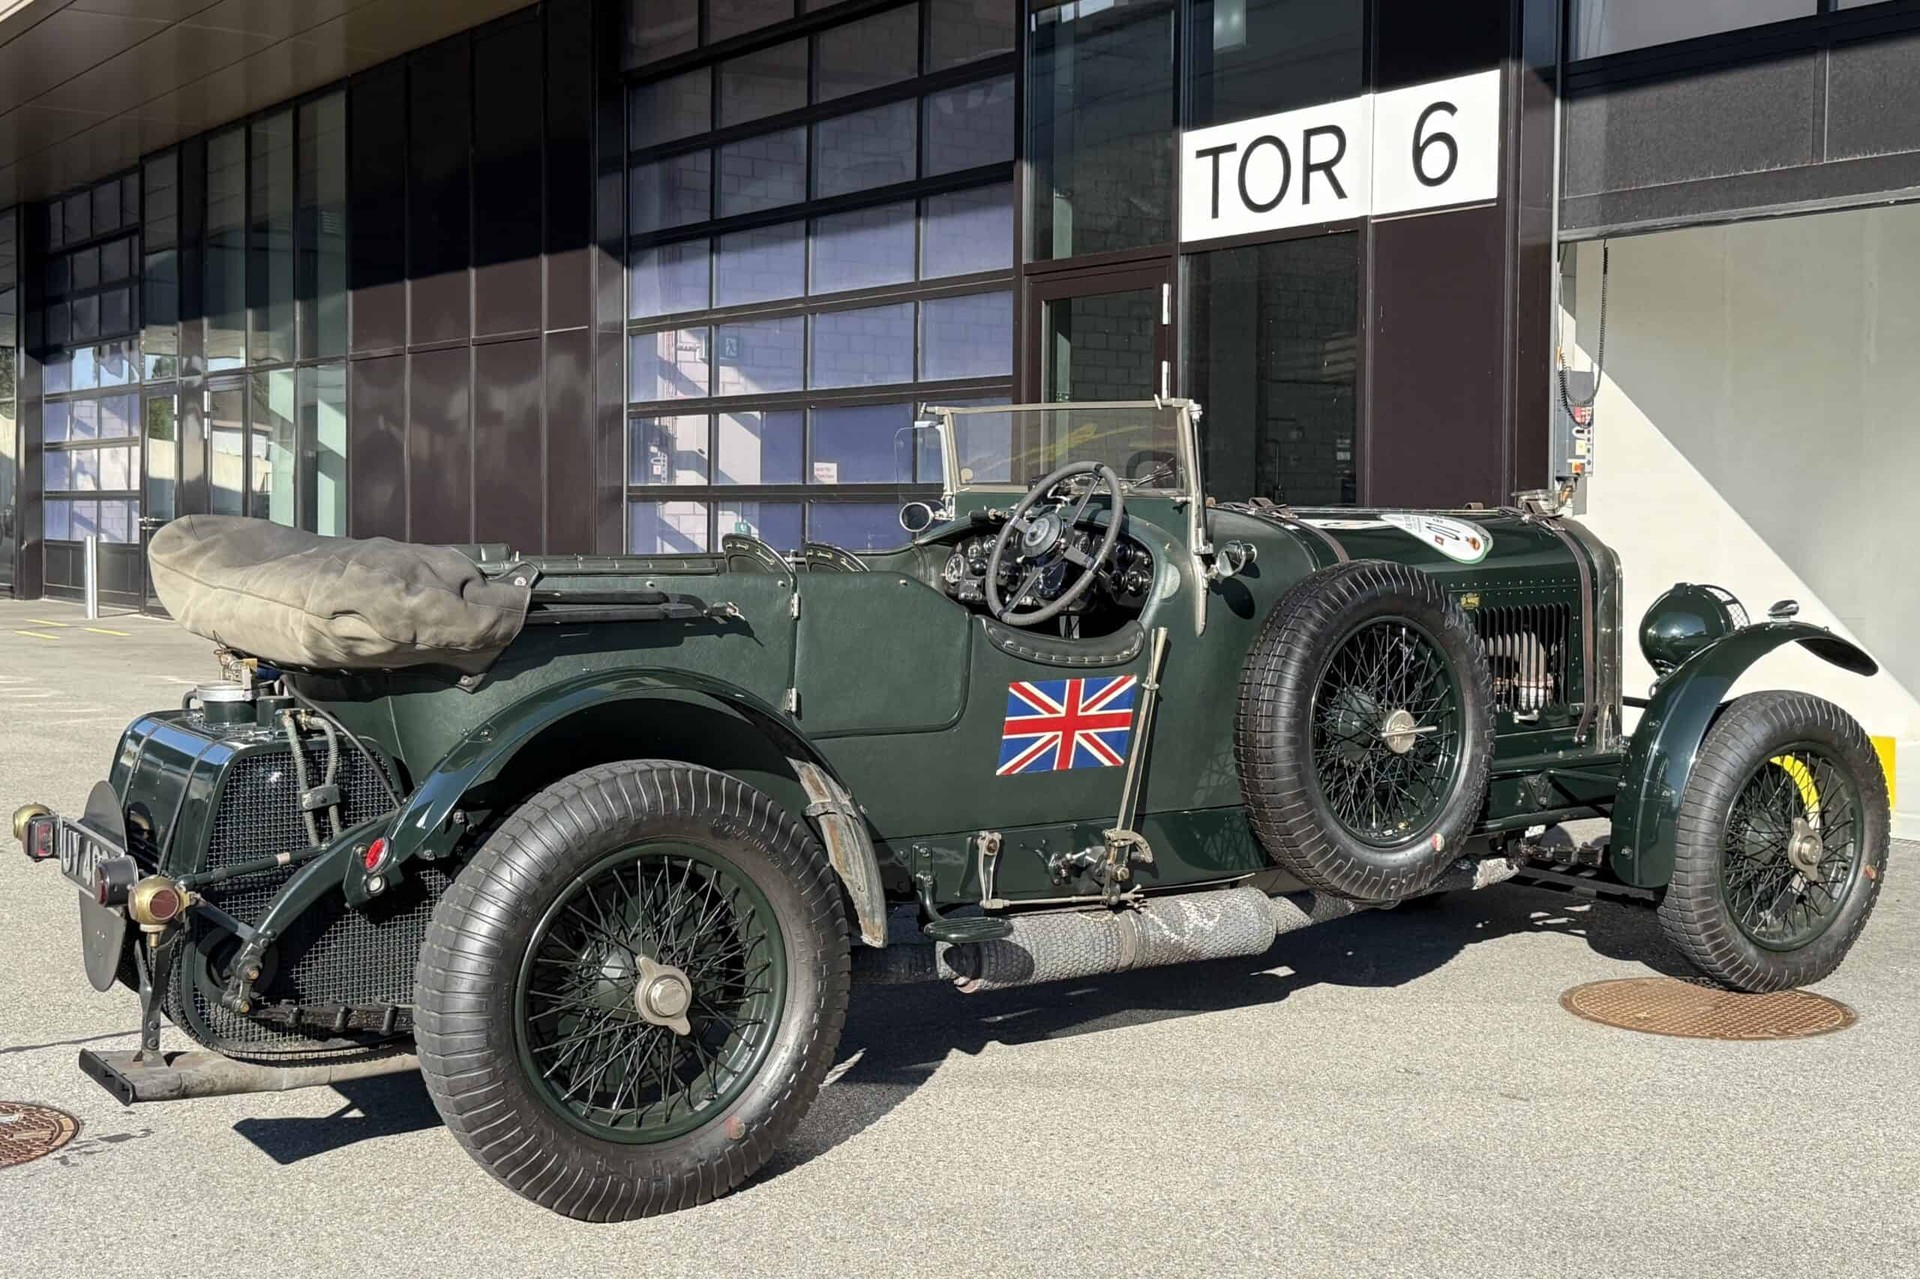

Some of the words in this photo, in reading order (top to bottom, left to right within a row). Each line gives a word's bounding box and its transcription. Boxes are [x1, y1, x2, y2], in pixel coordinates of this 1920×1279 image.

[1195, 124, 1348, 219] TOR
[1412, 101, 1458, 187] 6
[63, 827, 82, 875] UY
